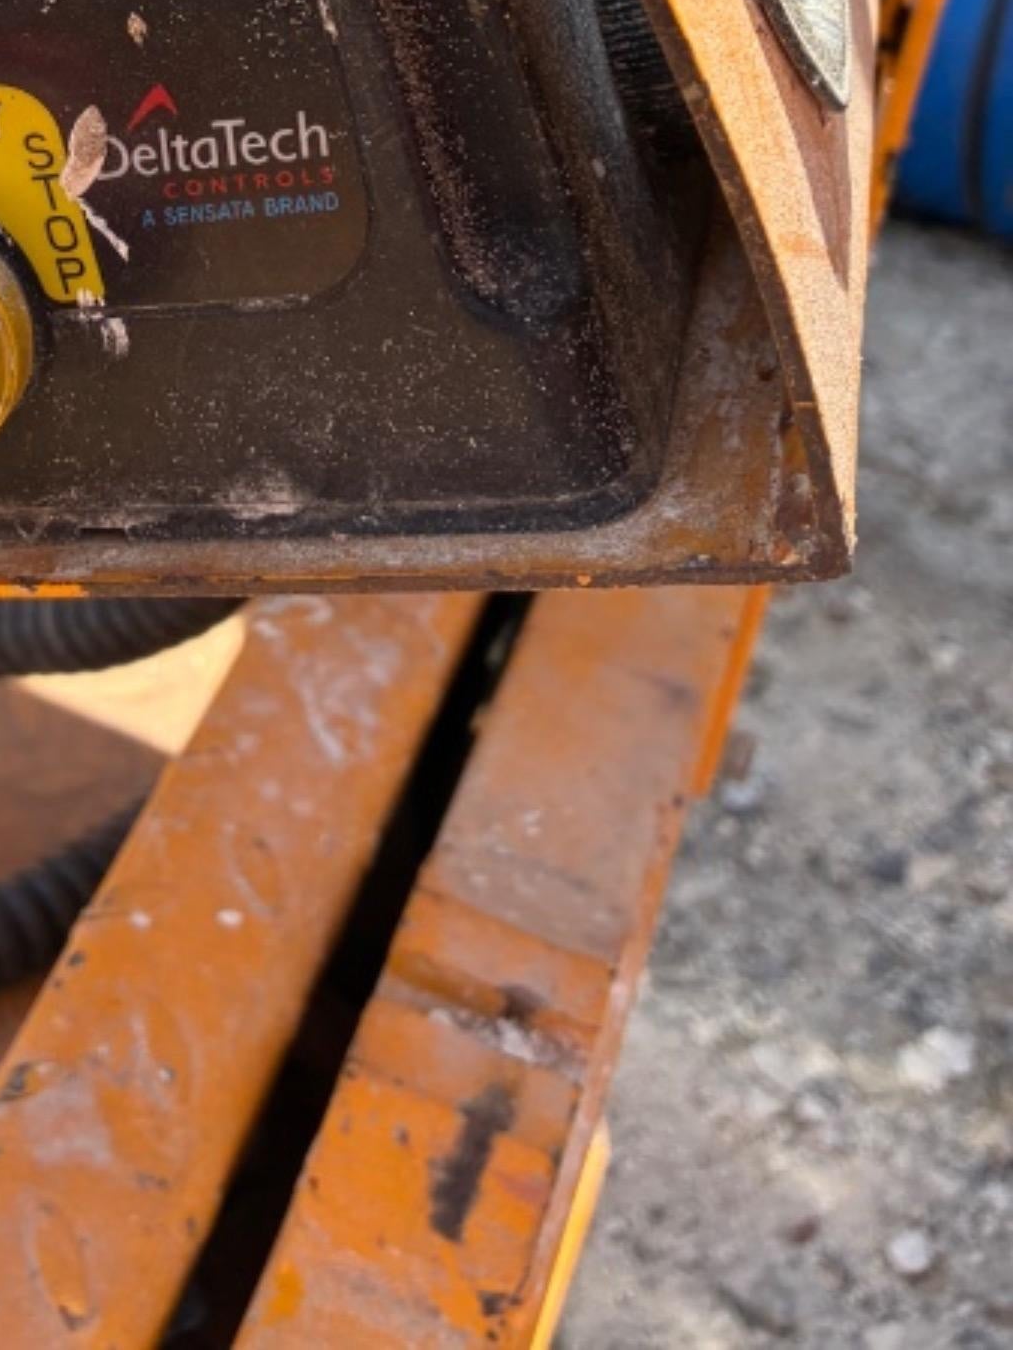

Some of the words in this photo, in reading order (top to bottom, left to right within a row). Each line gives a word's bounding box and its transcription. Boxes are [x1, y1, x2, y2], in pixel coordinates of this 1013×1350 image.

[96, 110, 330, 181] DeltaTech
[162, 164, 335, 198] CONTROLS
[23, 132, 86, 295] STOP
[142, 209, 156, 228] A
[163, 199, 255, 226] SENSATA
[264, 191, 339, 218] BRAND
